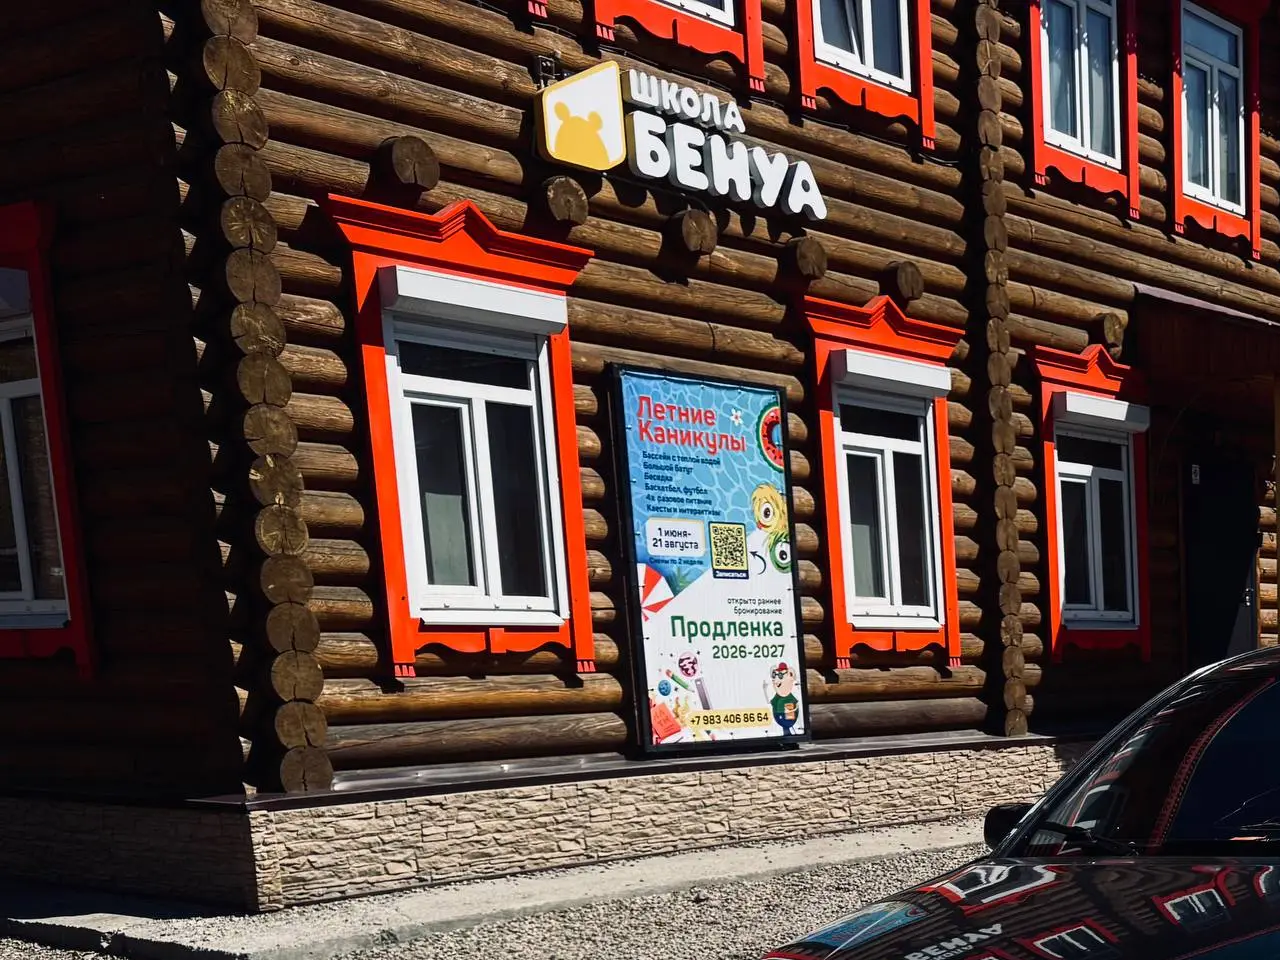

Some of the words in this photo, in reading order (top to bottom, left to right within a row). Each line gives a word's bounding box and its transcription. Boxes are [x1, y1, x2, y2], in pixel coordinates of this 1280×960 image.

[628, 68, 746, 133] ШКОЛА
[631, 110, 828, 220] БЕНУА
[637, 396, 716, 426] Летние
[638, 418, 746, 455] Каникулы
[642, 451, 671, 460] Бассейн
[643, 461, 674, 471] Большой
[675, 465, 693, 475] батут
[658, 527, 662, 537] 1
[664, 529, 691, 538] июня-
[652, 538, 663, 547] 21
[664, 540, 699, 551] августа
[727, 597, 756, 606] открыто
[757, 598, 781, 606] раннее
[734, 606, 782, 615] бронирование
[670, 615, 784, 643] Продленка
[712, 644, 785, 659] 2026-2027
[690, 715, 700, 725] +7
[702, 715, 721, 725] 983
[723, 714, 741, 724] 406
[743, 713, 755, 723] 86
[757, 712, 769, 722] 64
